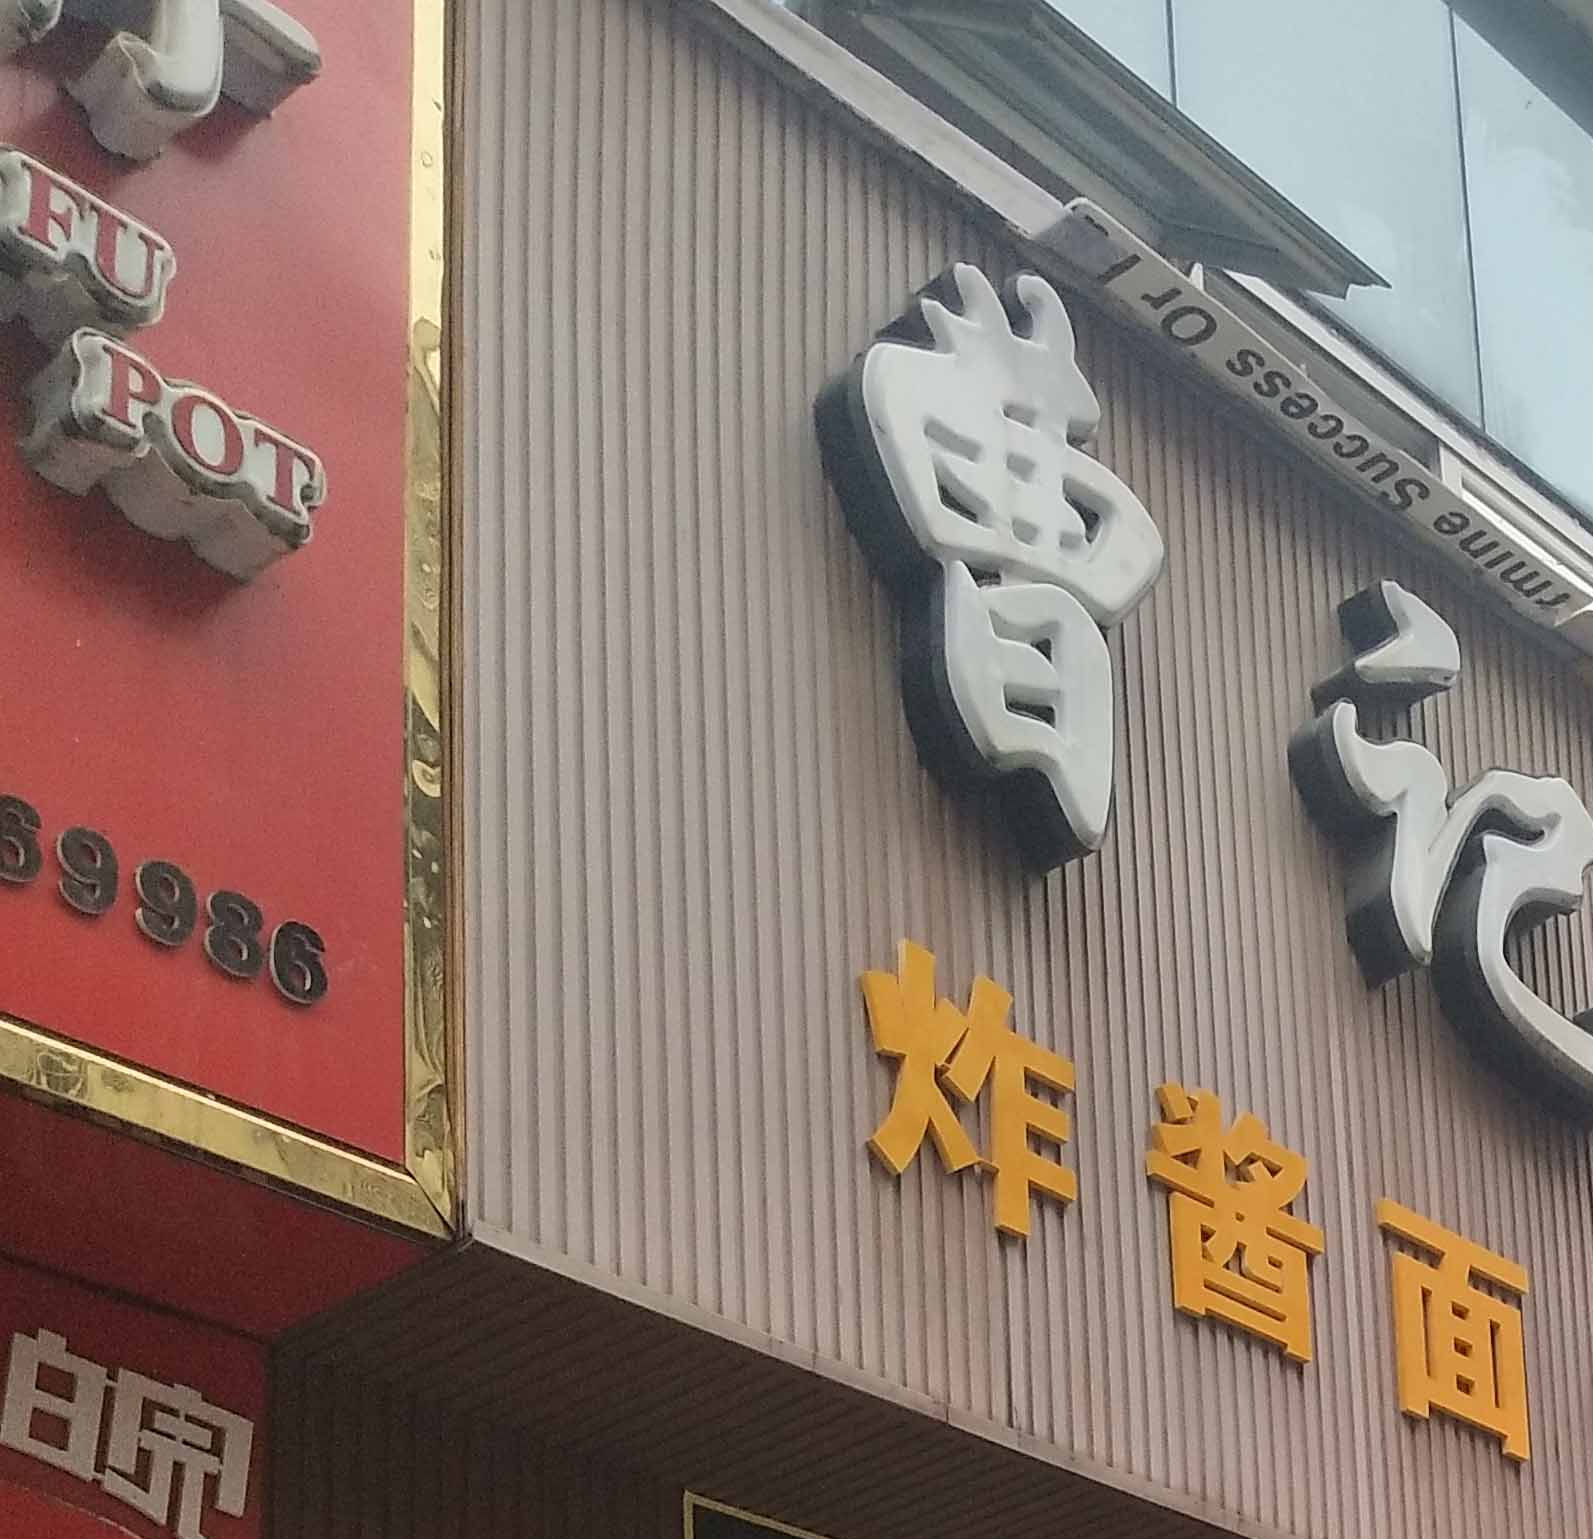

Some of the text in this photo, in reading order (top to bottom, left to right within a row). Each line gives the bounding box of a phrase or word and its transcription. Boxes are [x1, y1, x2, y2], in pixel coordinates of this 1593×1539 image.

[1140, 286, 1217, 347] Or
[92, 338, 322, 522] POT
[1225, 347, 1431, 513] Success
[858, 938, 1531, 1463] 炸酱面
